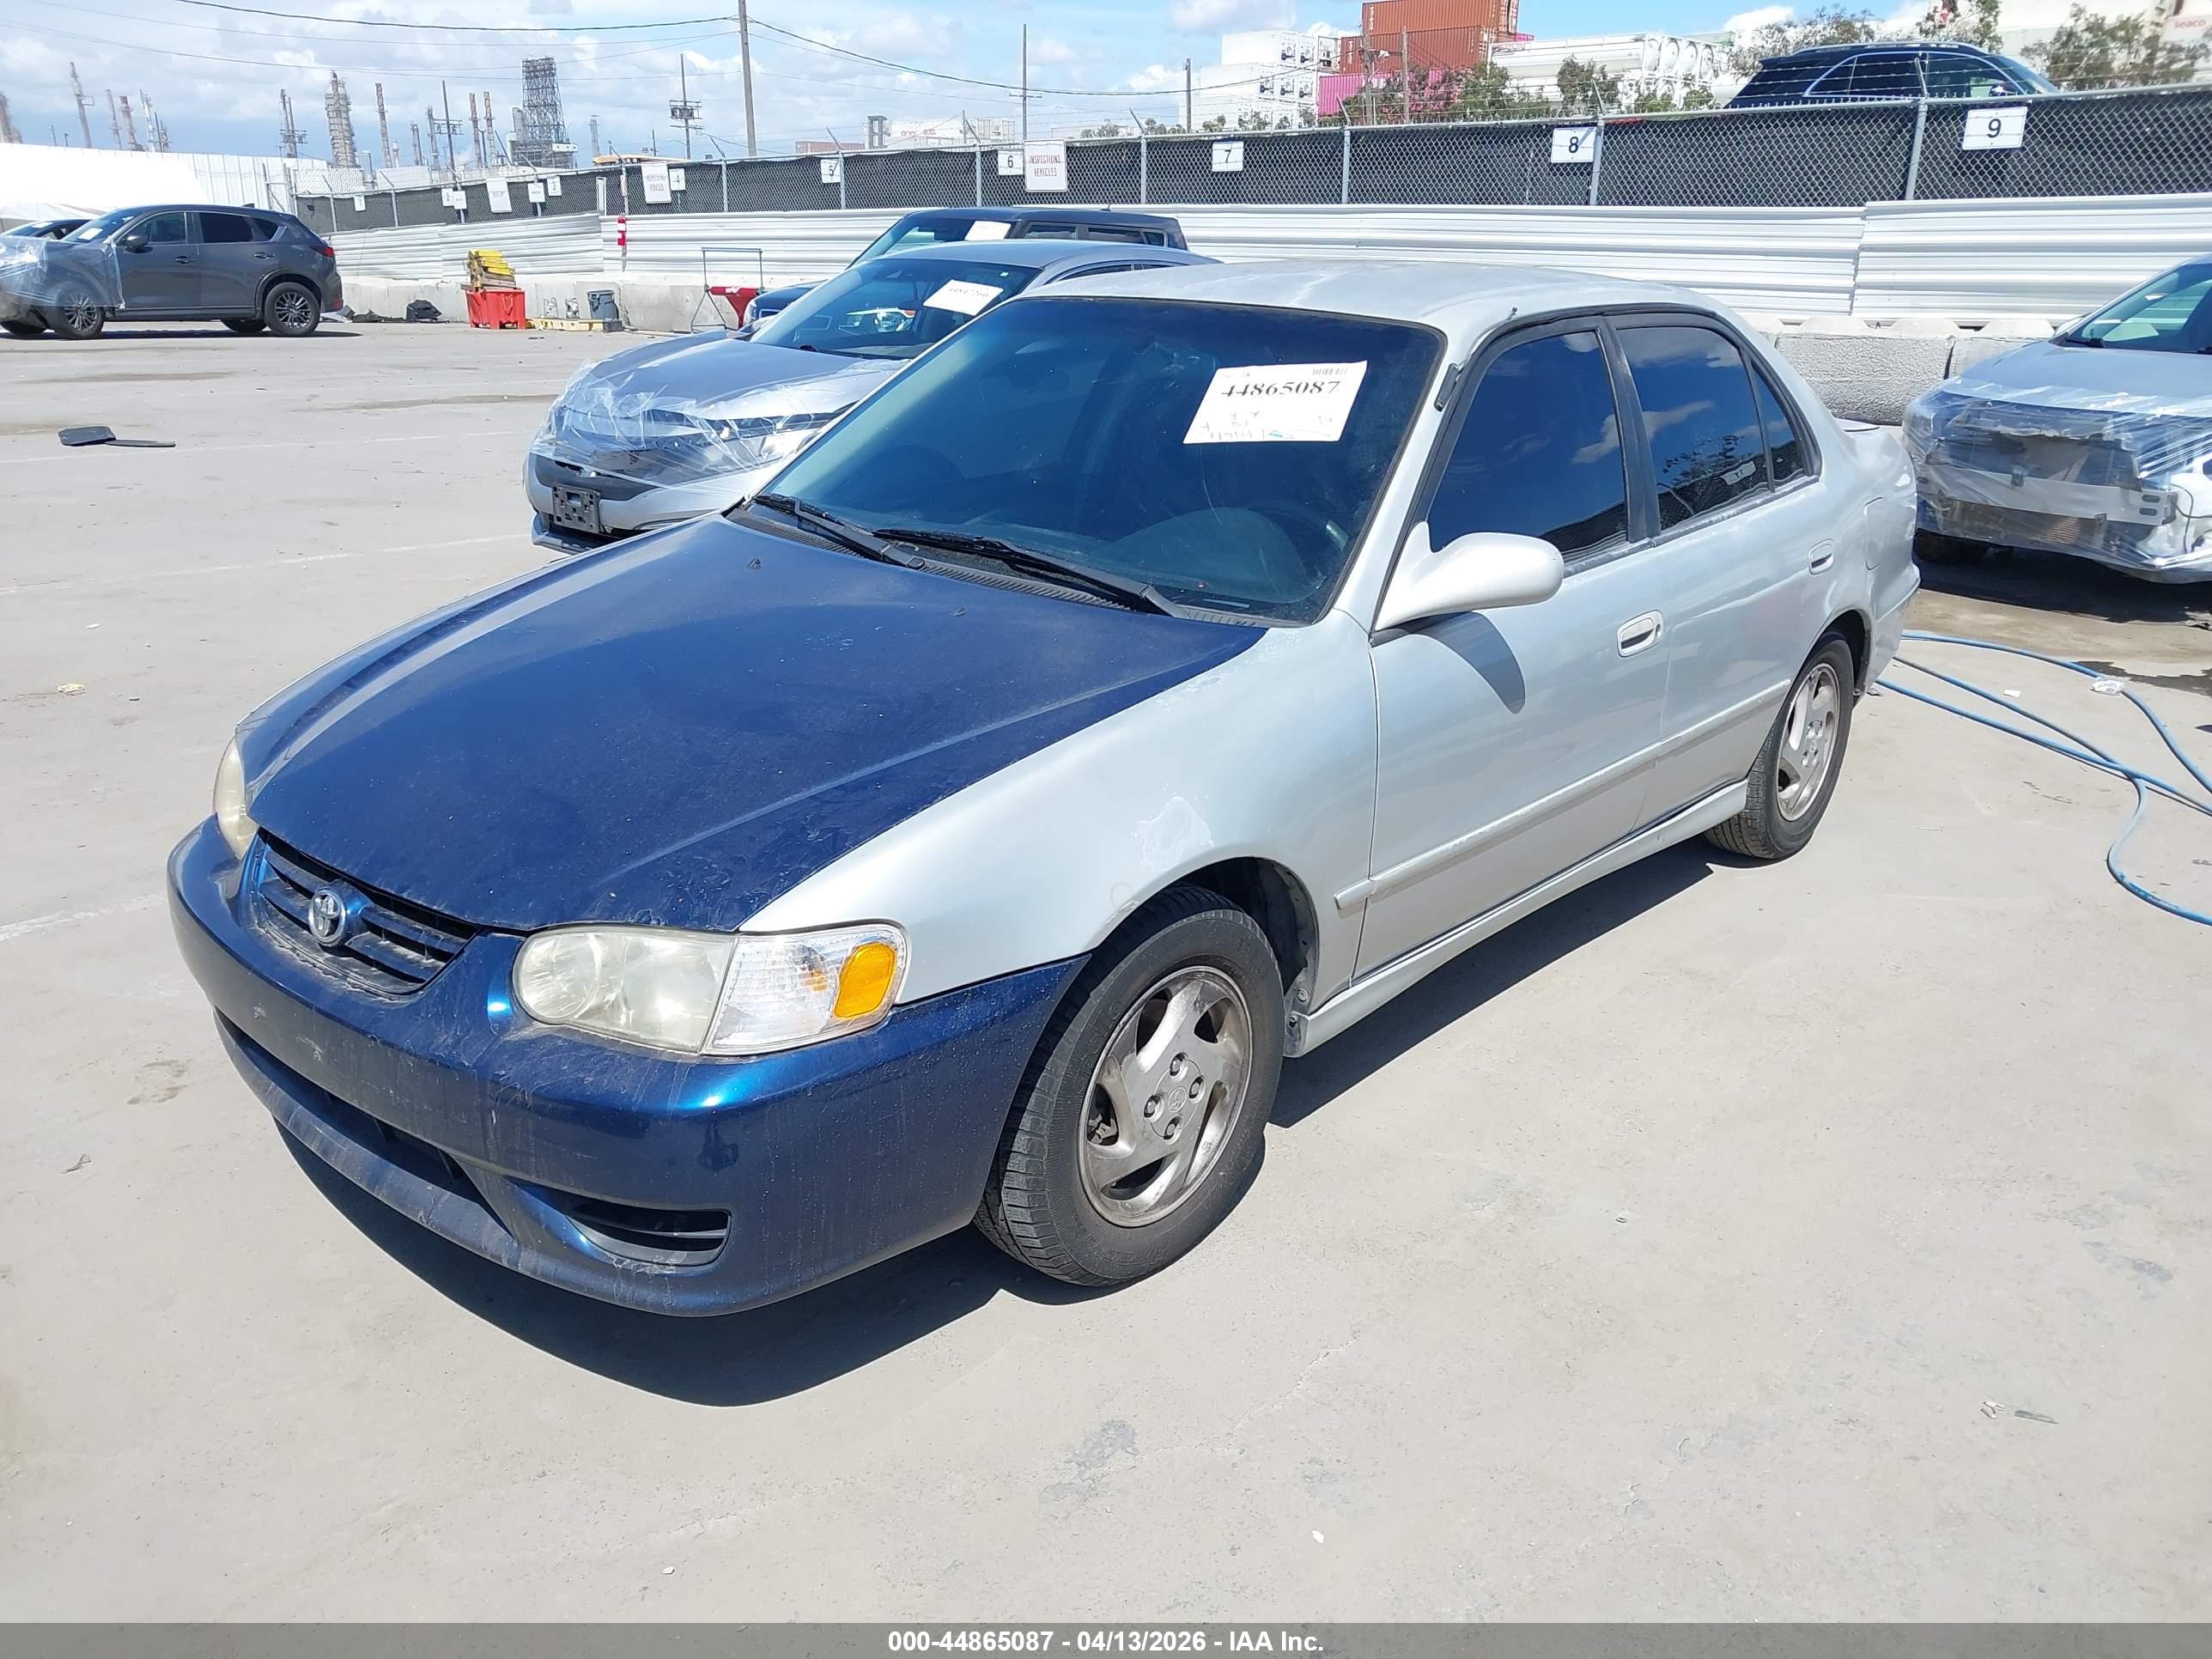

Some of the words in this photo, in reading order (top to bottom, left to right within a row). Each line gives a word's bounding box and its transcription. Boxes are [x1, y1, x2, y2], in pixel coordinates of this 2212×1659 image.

[1986, 118, 2002, 138] 9
[1568, 136, 1579, 154] 8
[1007, 155, 1014, 168] 6
[1029, 155, 1061, 164] INSPECTIONS
[1224, 149, 1232, 164] 7
[829, 165, 835, 177] 5
[1033, 167, 1058, 177] VEHICLES
[675, 174, 680, 186] 4
[1220, 380, 1342, 398] 44865087
